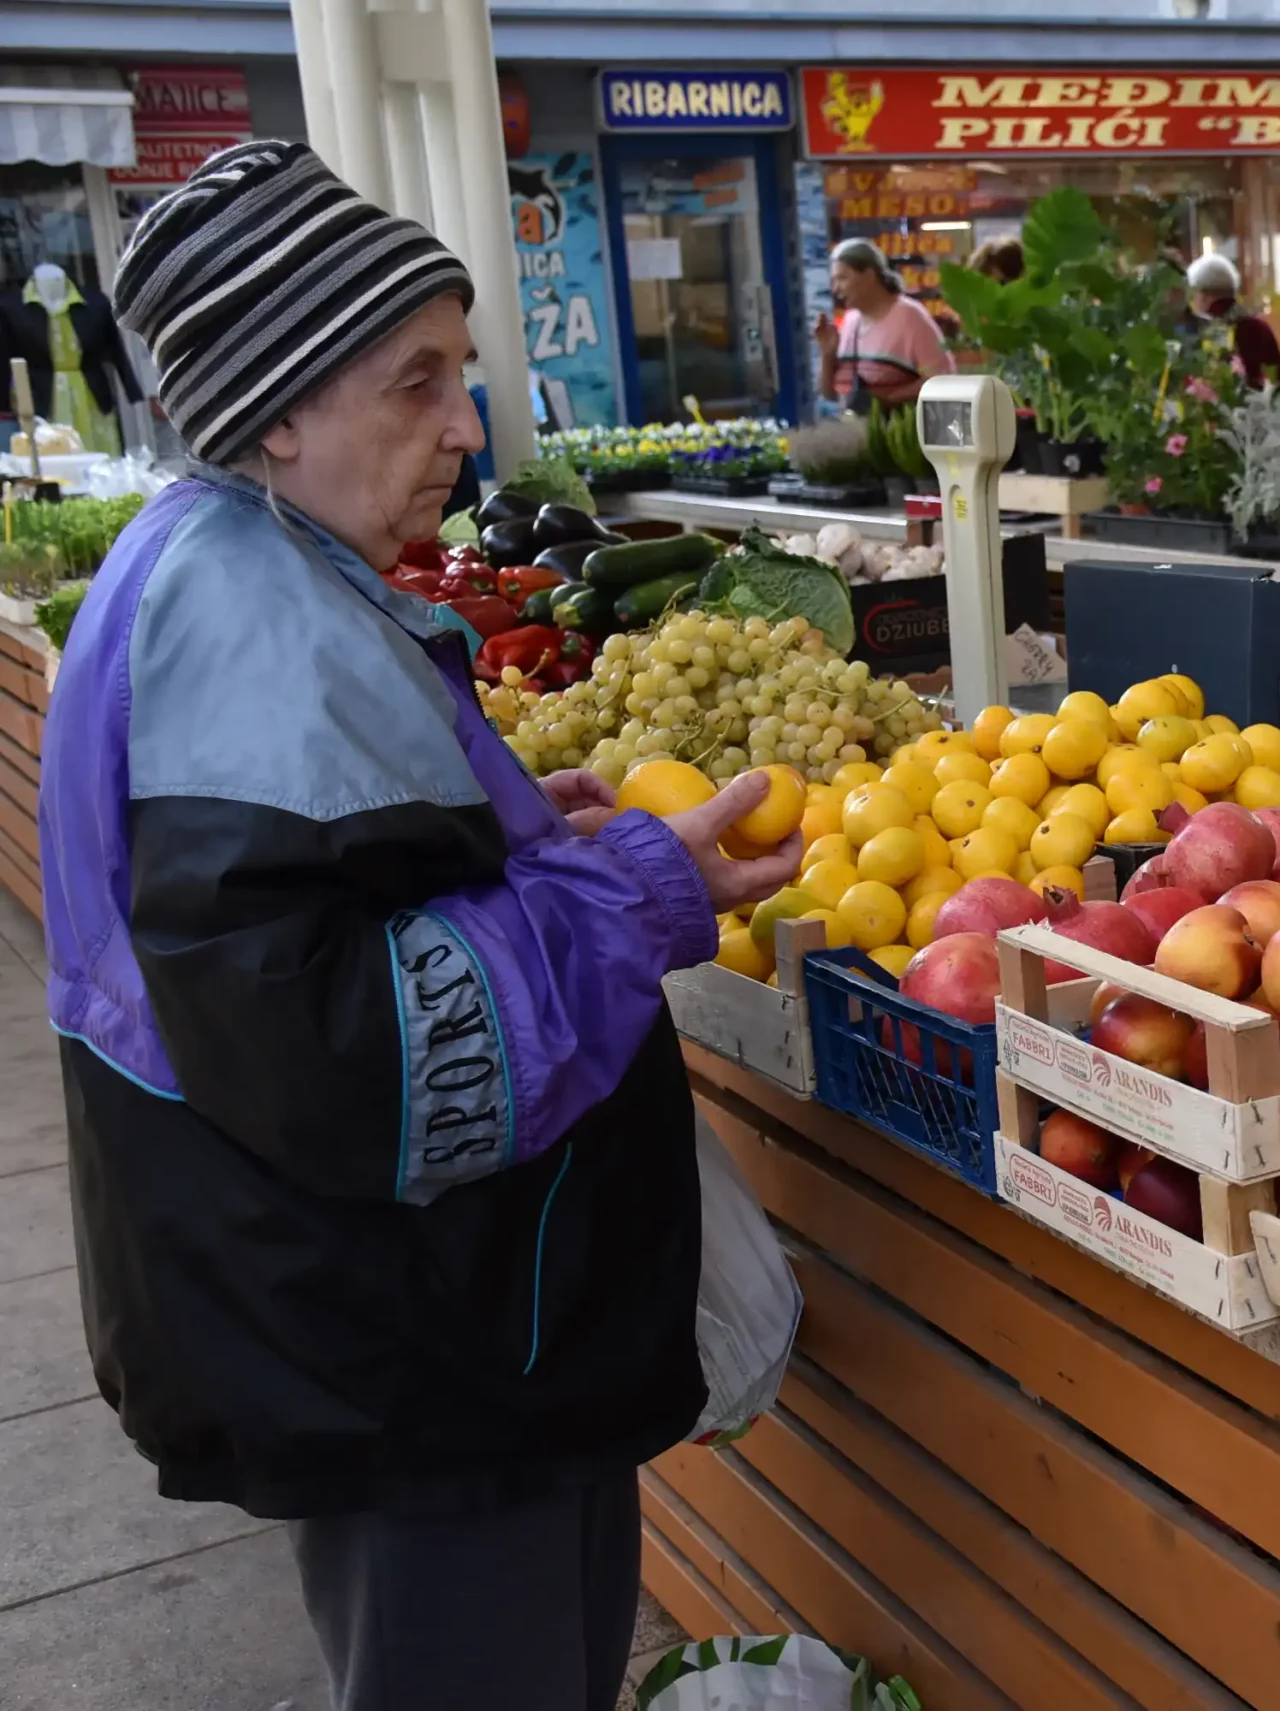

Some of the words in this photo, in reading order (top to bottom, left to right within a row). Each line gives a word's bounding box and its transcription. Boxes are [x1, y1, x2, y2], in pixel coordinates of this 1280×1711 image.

[609, 80, 784, 118] RIBARNICA
[934, 108, 1170, 149] PILIĆI
[136, 142, 220, 160] ALITETNO
[529, 284, 599, 361] ŽA
[876, 617, 950, 643] DZIUBE
[1012, 1031, 1052, 1061] FABBRI
[1113, 1066, 1173, 1108] ARANDIS
[1013, 1169, 1053, 1201] FABBRI
[1113, 1214, 1173, 1258] ARANDIS
